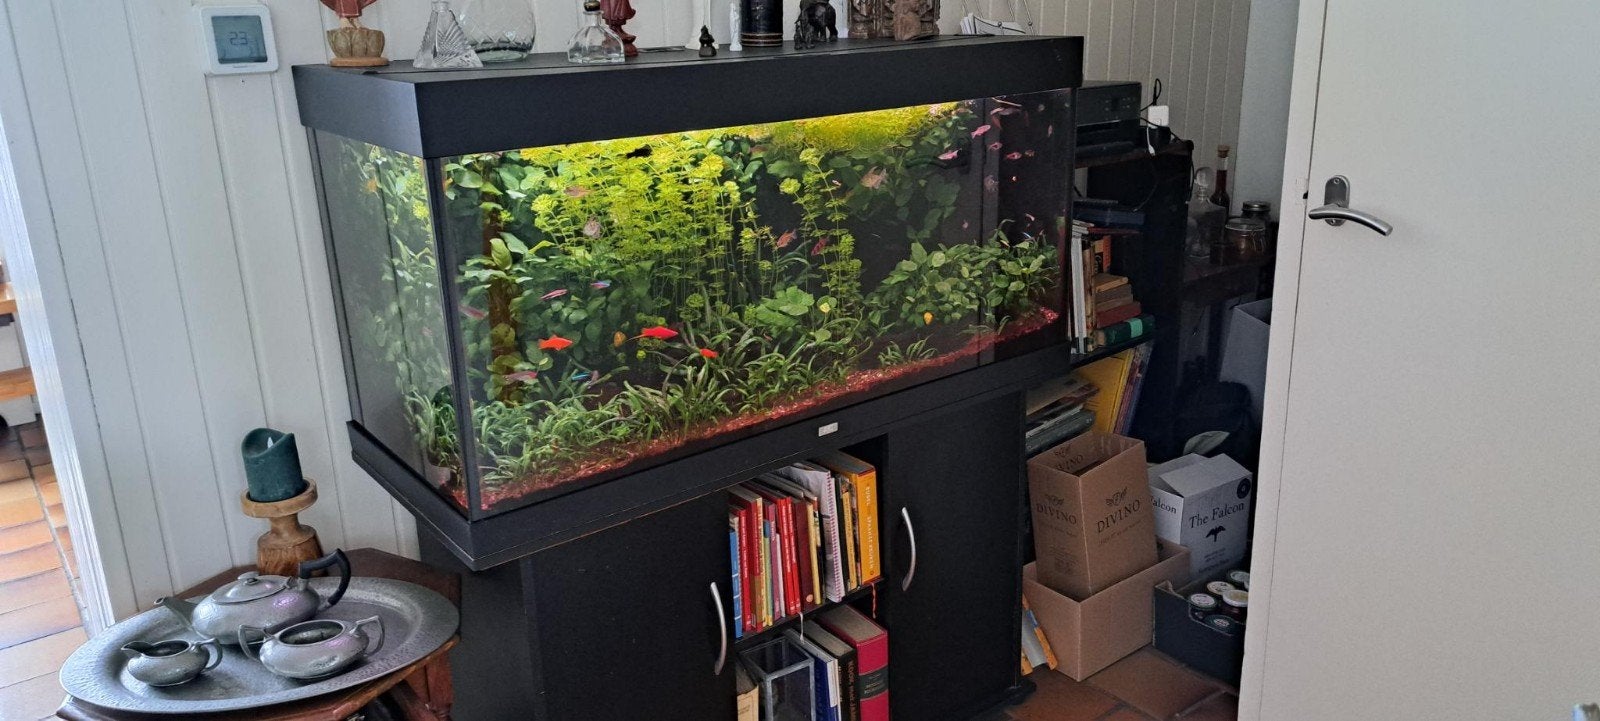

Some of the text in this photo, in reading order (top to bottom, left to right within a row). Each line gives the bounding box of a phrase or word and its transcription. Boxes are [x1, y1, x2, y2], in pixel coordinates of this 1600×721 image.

[1036, 503, 1077, 525] DIVINO
[1097, 499, 1141, 534] DIVINO
[1150, 496, 1177, 514] alcon
[1189, 502, 1245, 528] The Falcon
